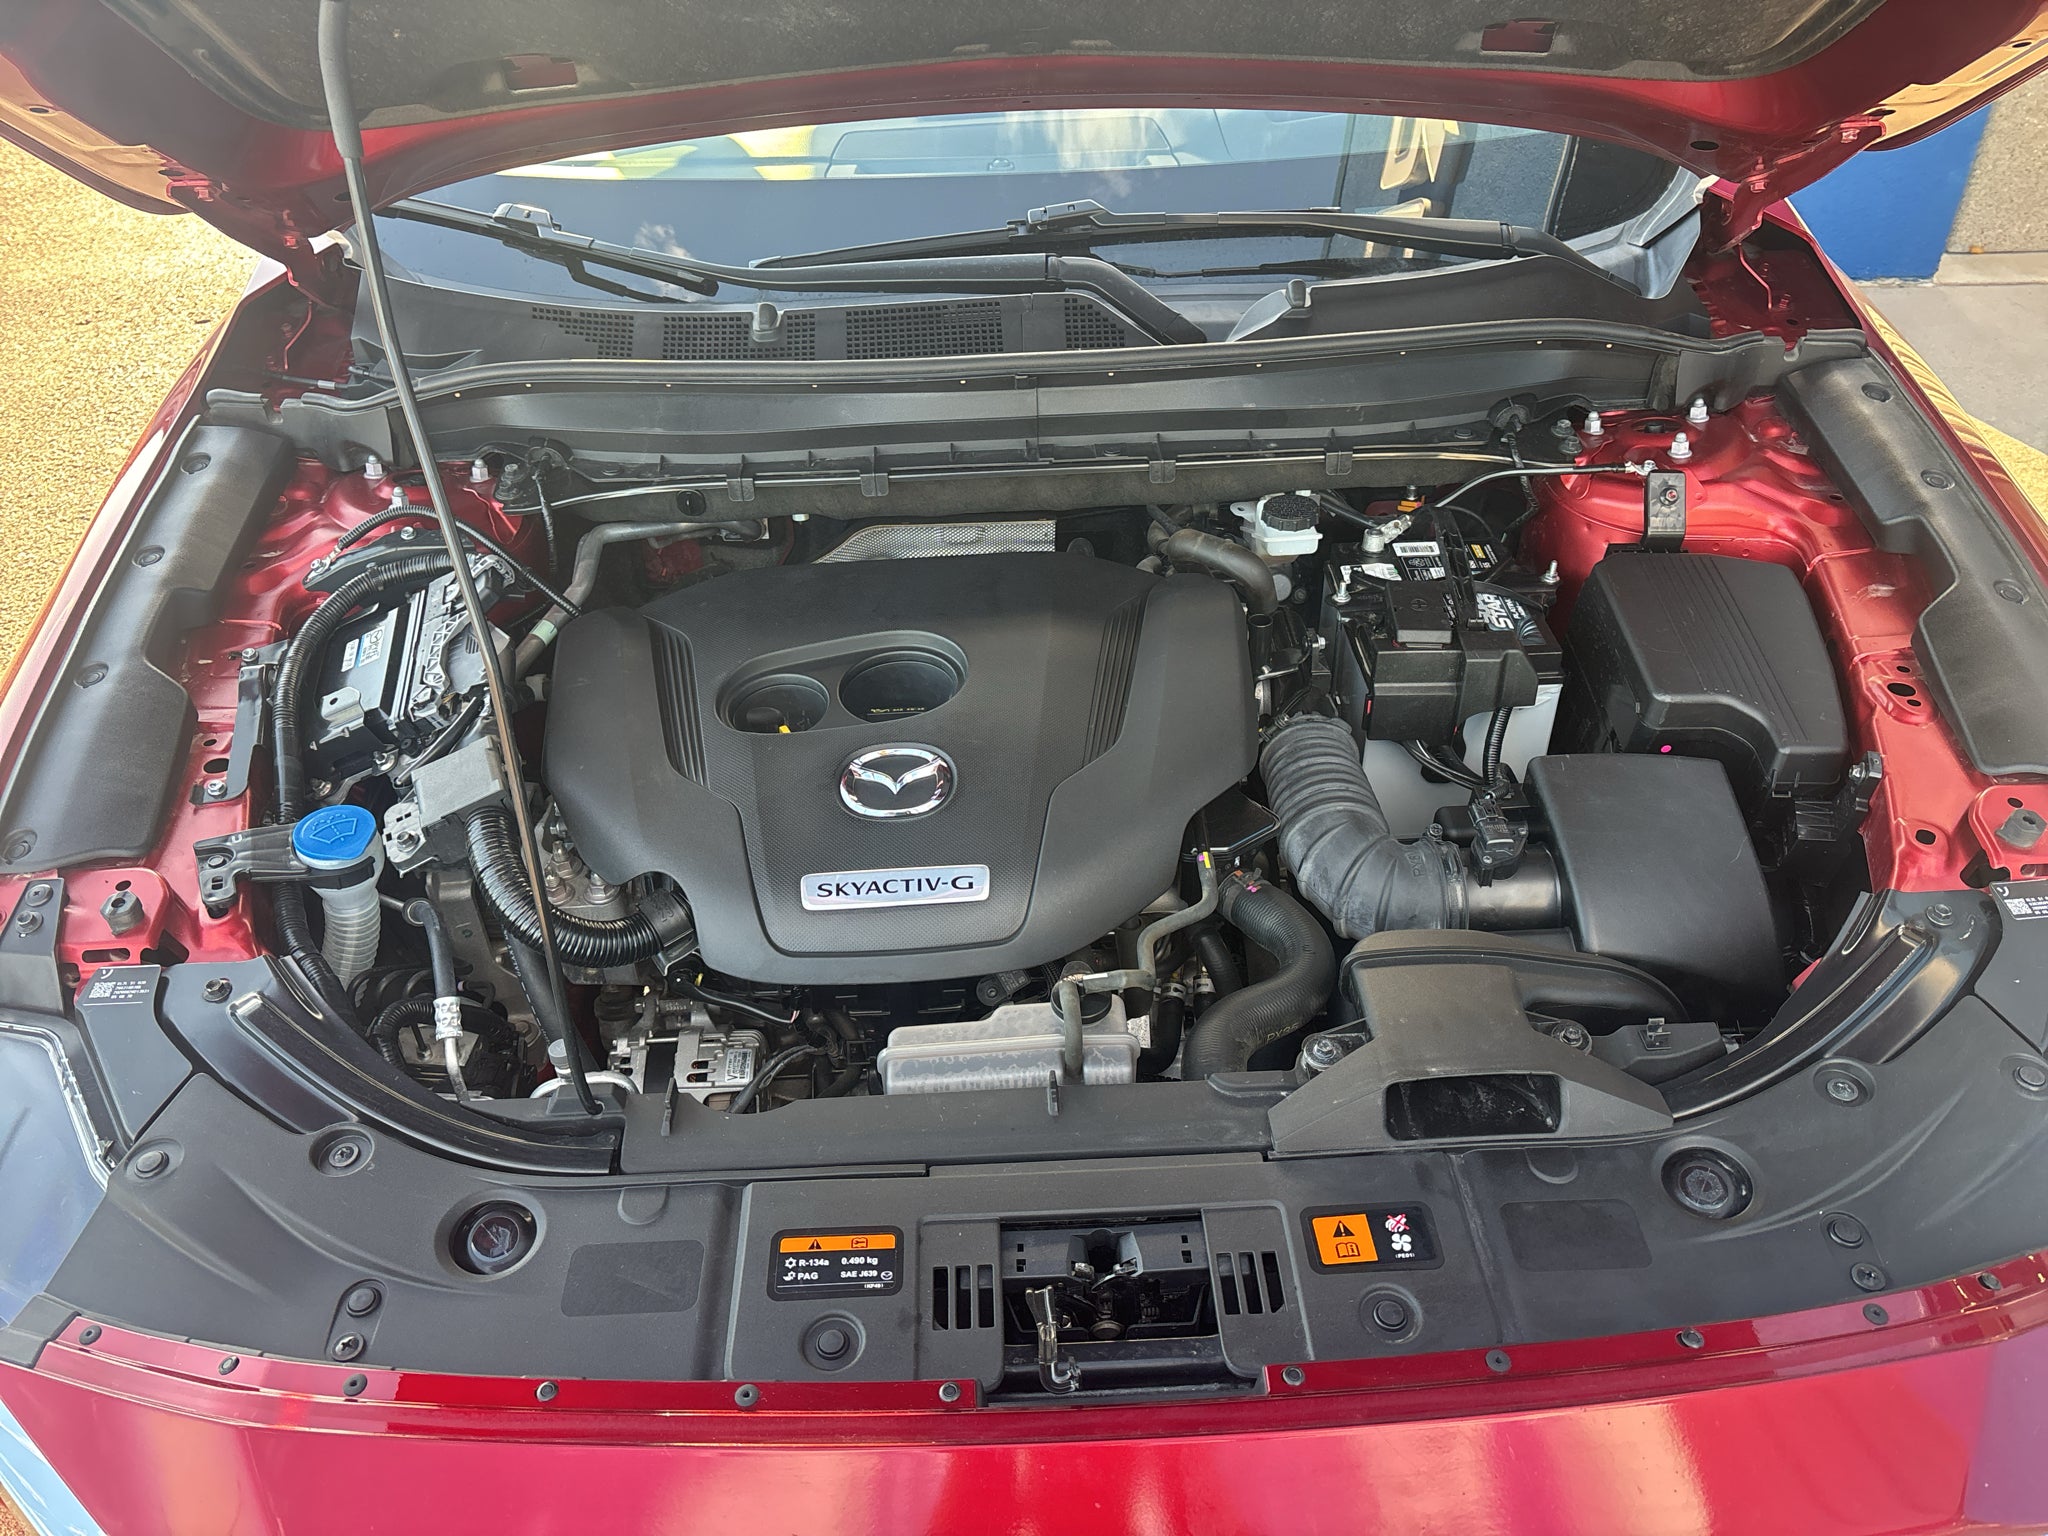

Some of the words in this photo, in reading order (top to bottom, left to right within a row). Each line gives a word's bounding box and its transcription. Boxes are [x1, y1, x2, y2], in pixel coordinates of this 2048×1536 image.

[816, 875, 974, 898] SKYACTIV-G
[798, 1258, 830, 1267] R-134a
[841, 1256, 865, 1265] 0.490
[867, 1256, 879, 1266] kg
[797, 1272, 819, 1281] PAG
[840, 1270, 858, 1278] SAE
[859, 1270, 878, 1278] J639
